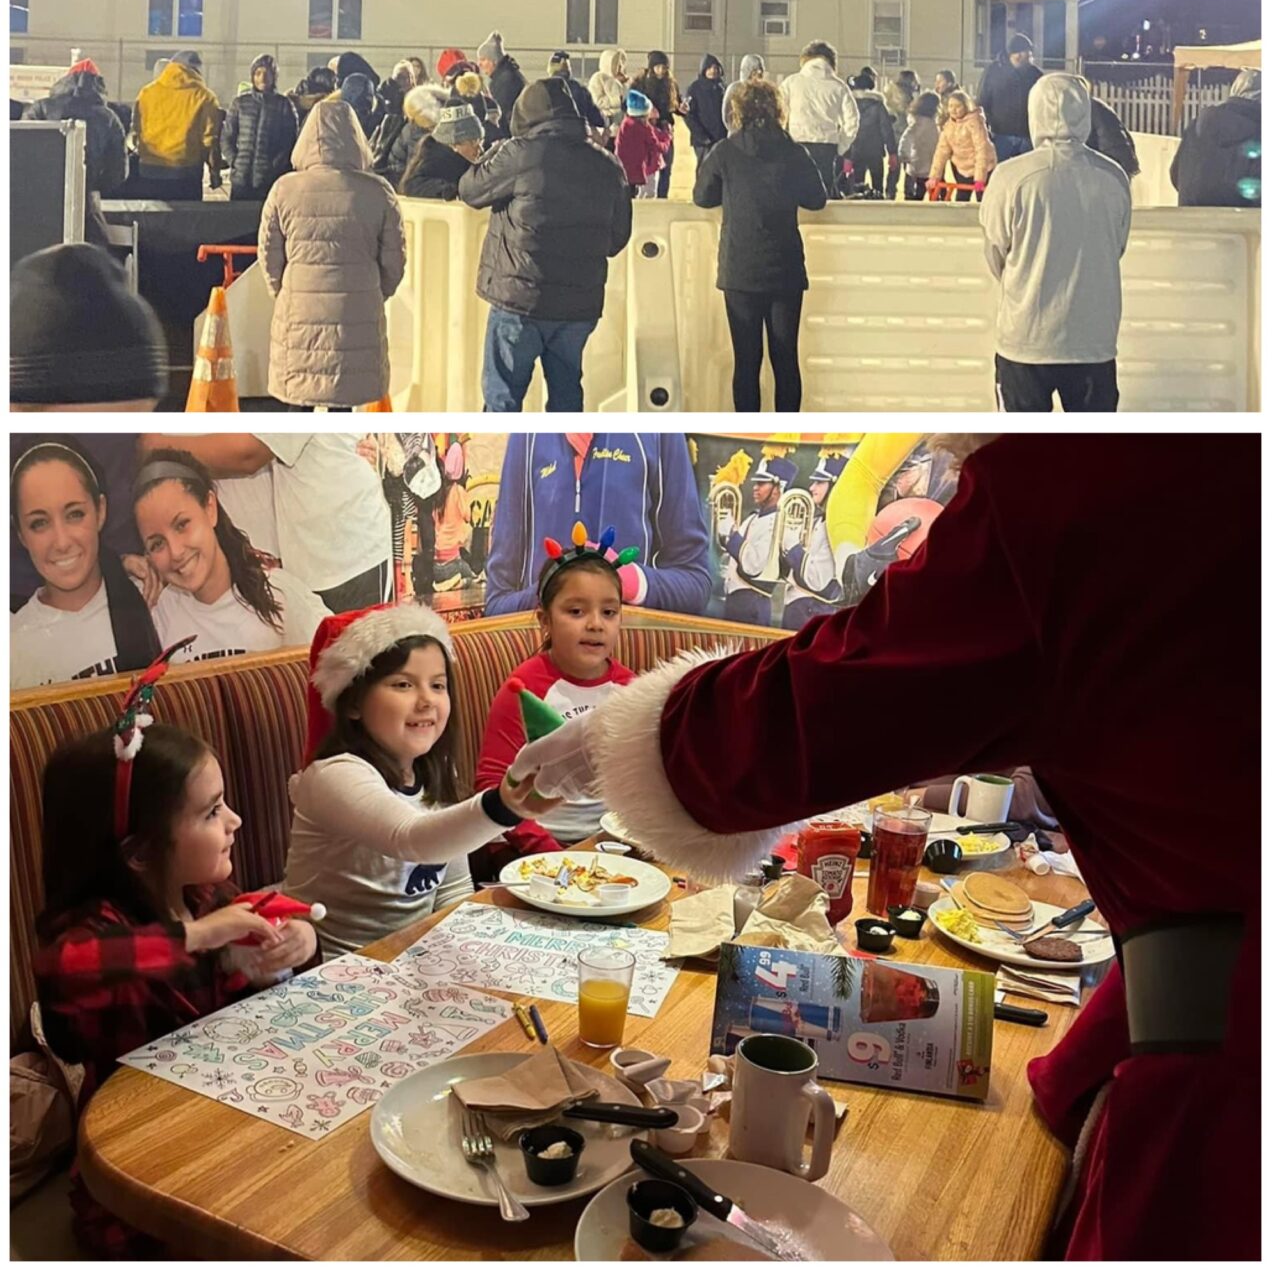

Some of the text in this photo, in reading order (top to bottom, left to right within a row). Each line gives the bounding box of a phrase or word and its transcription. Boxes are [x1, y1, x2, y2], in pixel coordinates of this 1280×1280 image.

[505, 931, 587, 953] MERR
[232, 986, 398, 1071] CHRISTMAS
[312, 1011, 412, 1068] MERRY
[895, 1023, 907, 1044] Vodka
